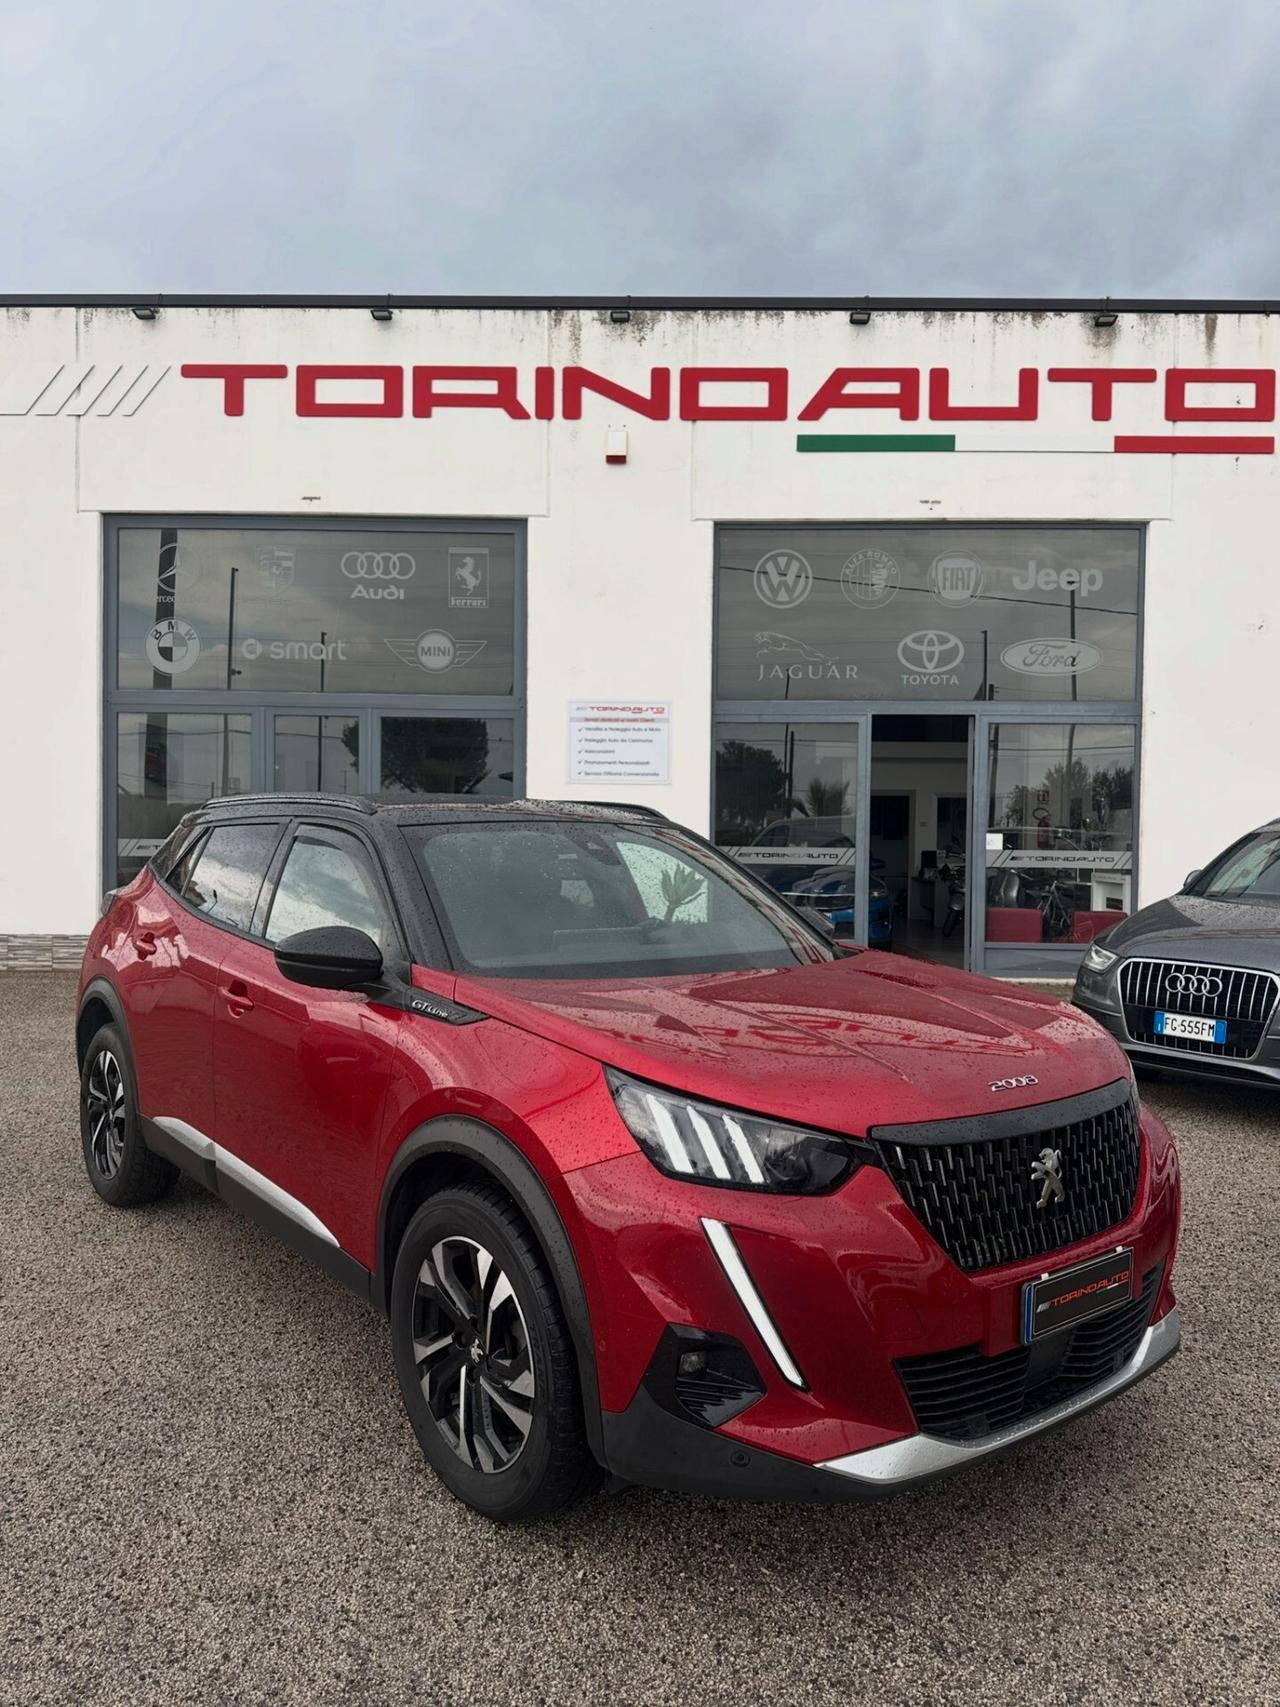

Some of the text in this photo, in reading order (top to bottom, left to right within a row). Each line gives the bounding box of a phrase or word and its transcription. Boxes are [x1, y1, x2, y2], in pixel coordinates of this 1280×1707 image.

[181, 364, 1275, 422] TORINOAUTO
[942, 567, 975, 591] FIAT
[1012, 560, 1104, 596] Jeep
[350, 584, 405, 600] Audi
[449, 597, 488, 607] Ferrari
[151, 620, 197, 641] BMW
[270, 639, 347, 661] smart
[420, 646, 452, 657] MINI
[1022, 643, 1081, 667] Ford
[757, 664, 858, 681] JAGUAR
[901, 674, 959, 686] TOYOTA
[1026, 855, 1115, 863] TORINOAUTO
[988, 1074, 1039, 1091] 2008
[1051, 1270, 1129, 1305] TORINOAUTO
